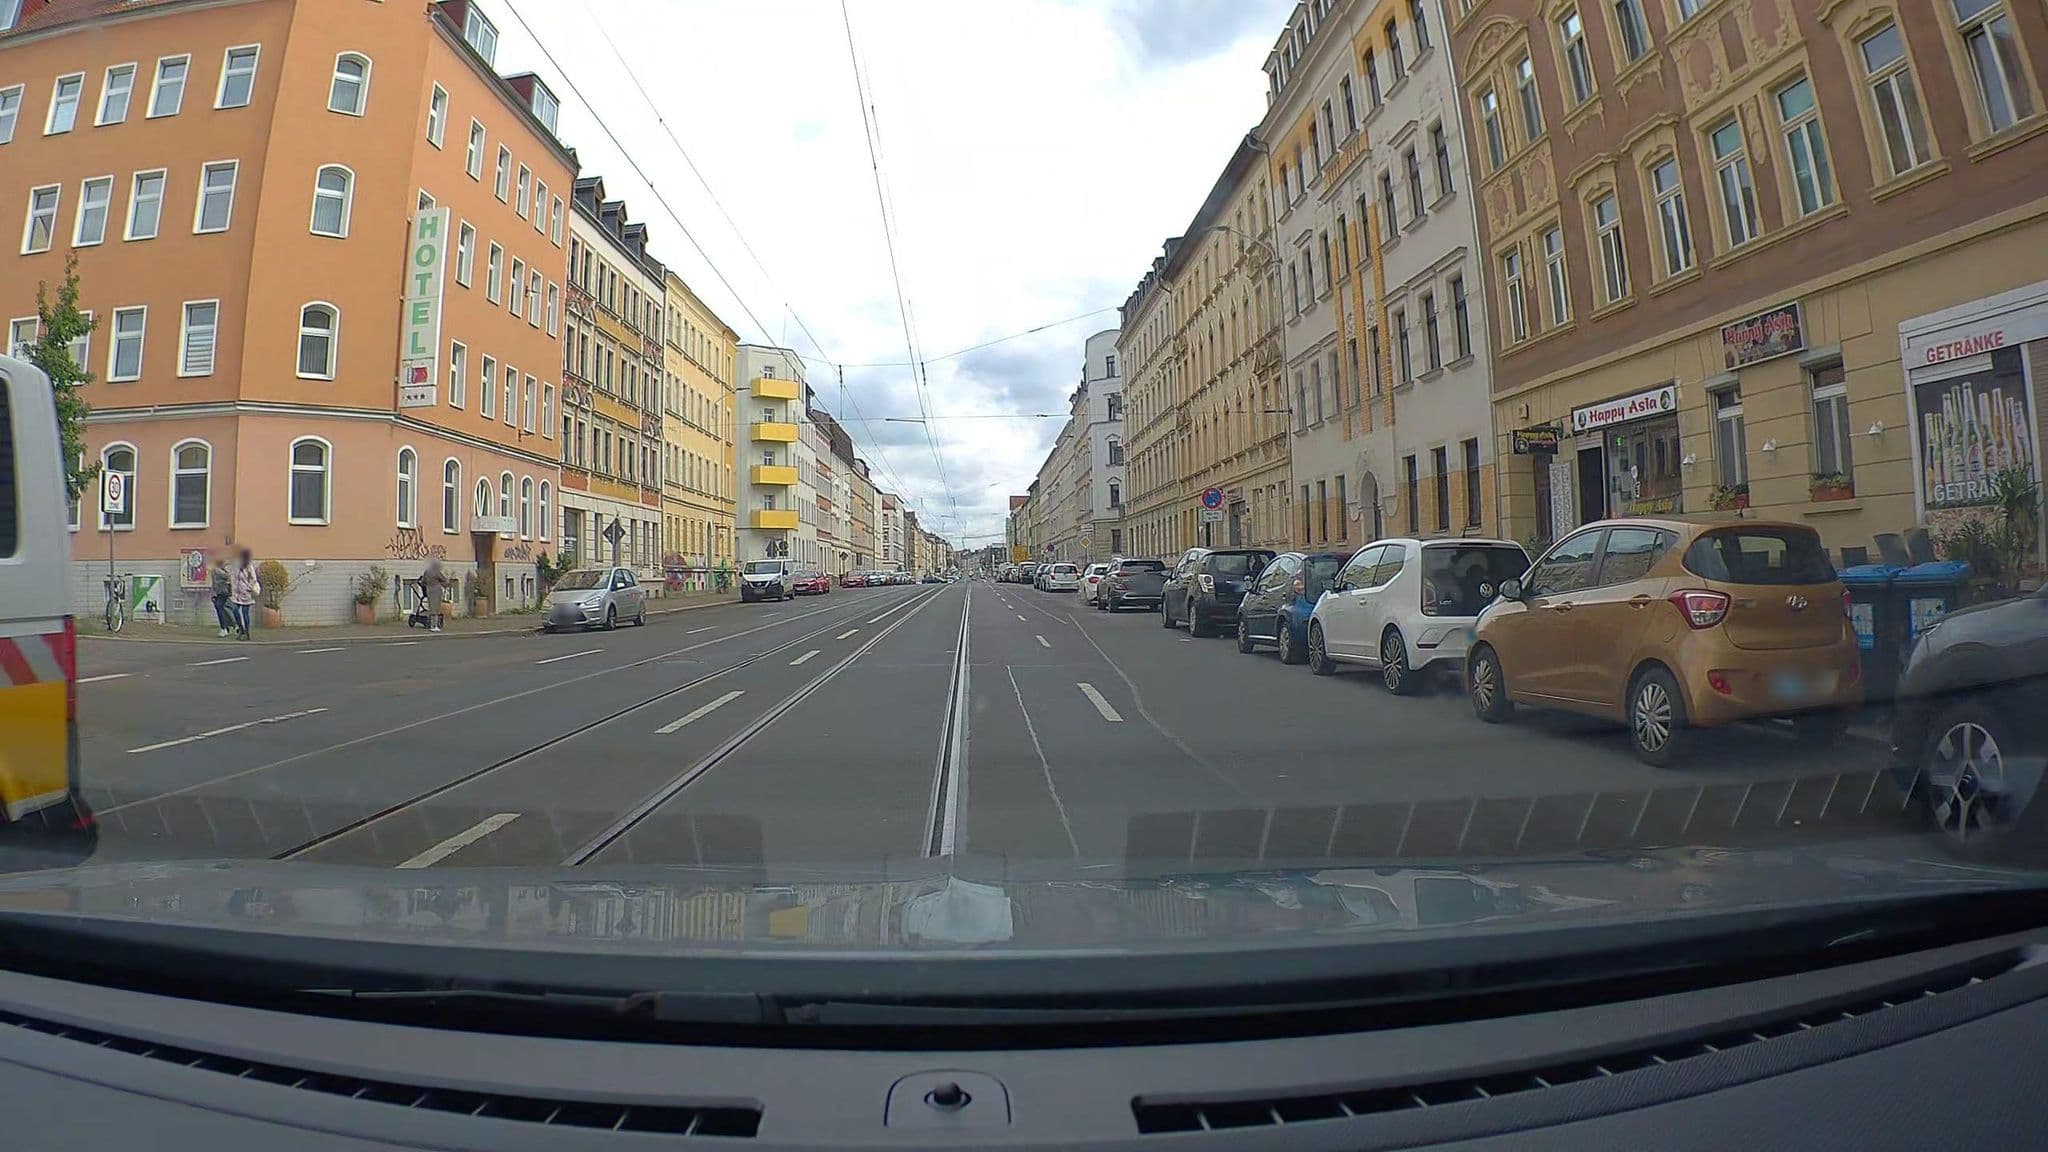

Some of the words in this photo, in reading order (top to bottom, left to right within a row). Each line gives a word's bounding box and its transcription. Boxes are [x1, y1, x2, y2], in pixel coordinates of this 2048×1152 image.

[411, 216, 438, 355] HOTEL
[1926, 330, 2004, 363] GETRÄNKE
[1589, 406, 1625, 423] Happy
[1629, 397, 1657, 412] Asia
[111, 480, 119, 494] 30
[1934, 474, 2002, 502] GETRÄN
